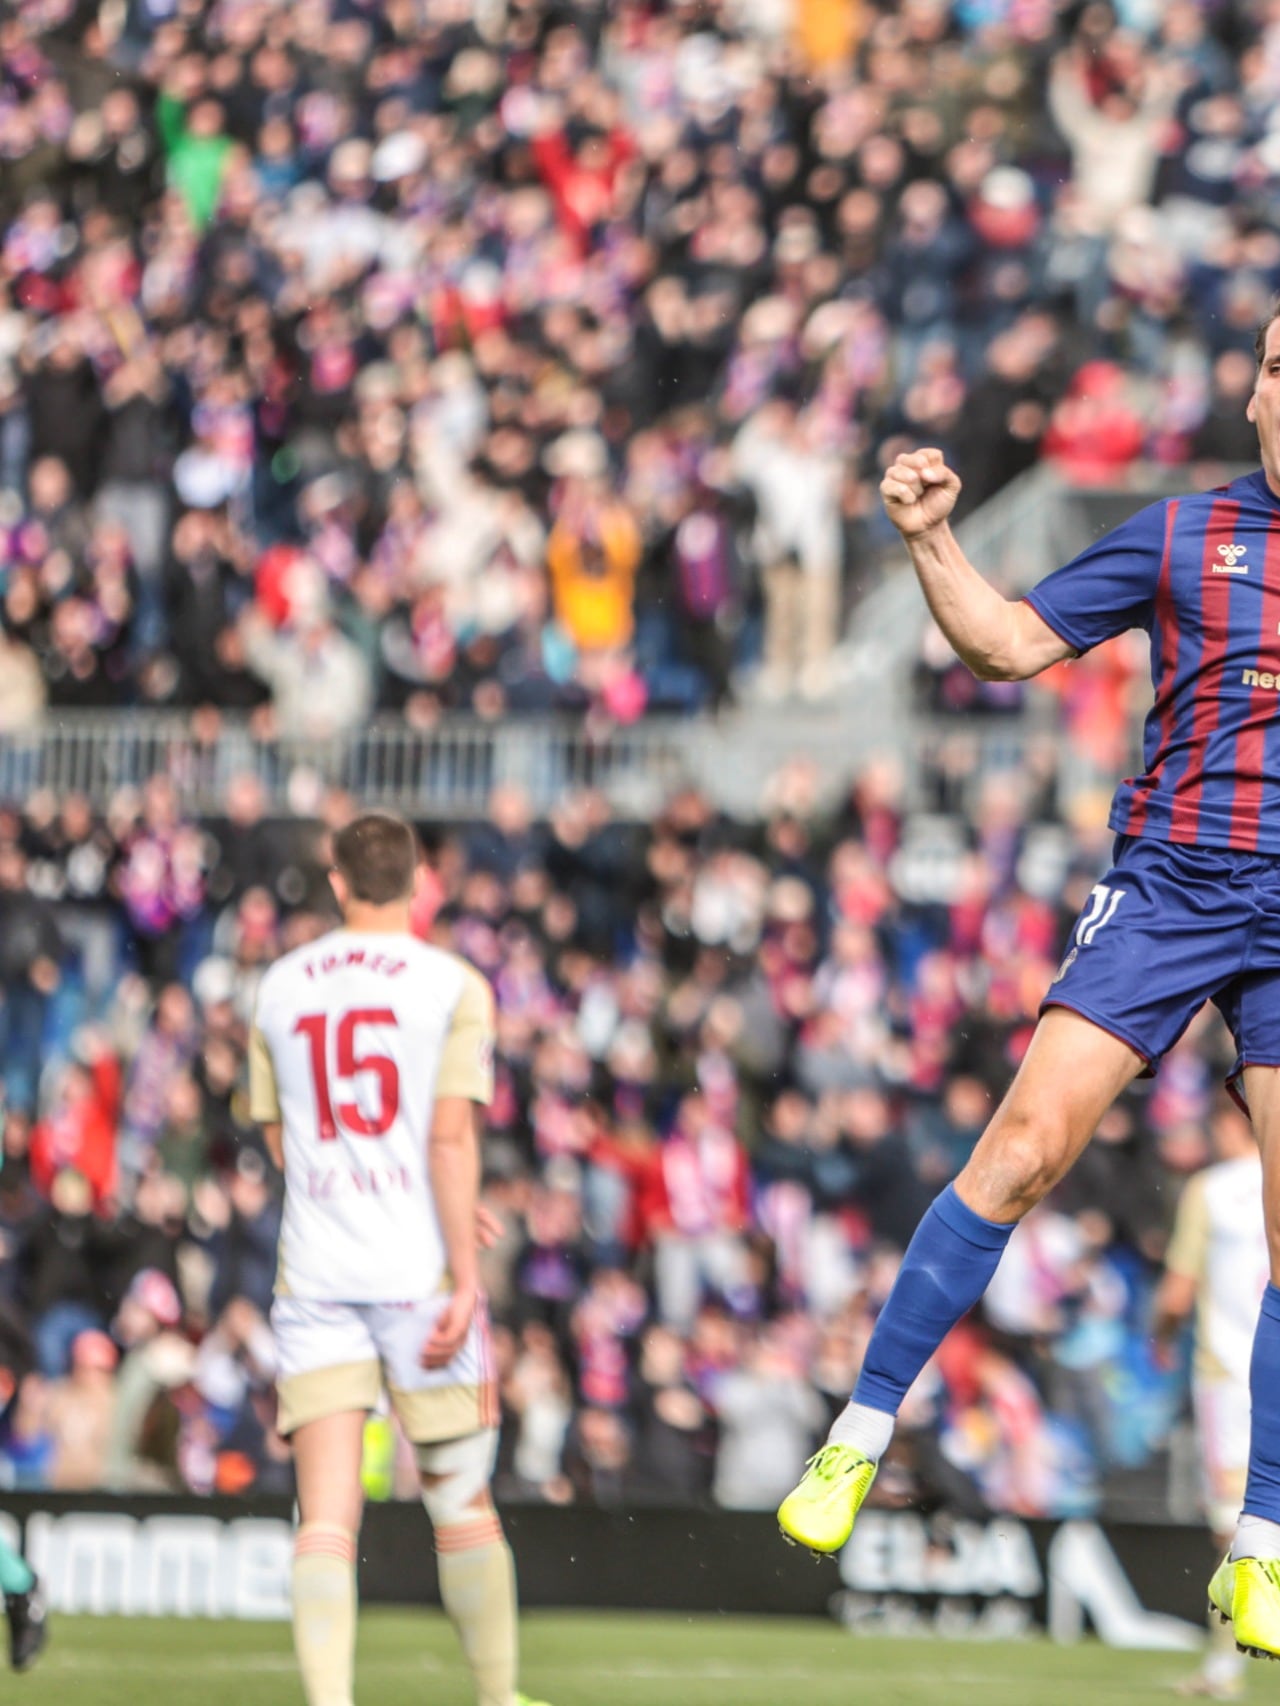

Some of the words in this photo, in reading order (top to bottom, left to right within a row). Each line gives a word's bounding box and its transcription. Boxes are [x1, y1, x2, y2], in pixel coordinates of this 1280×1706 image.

[1212, 563, 1248, 574] hummel
[1076, 884, 1127, 945] 11
[294, 1008, 400, 1141] 15
